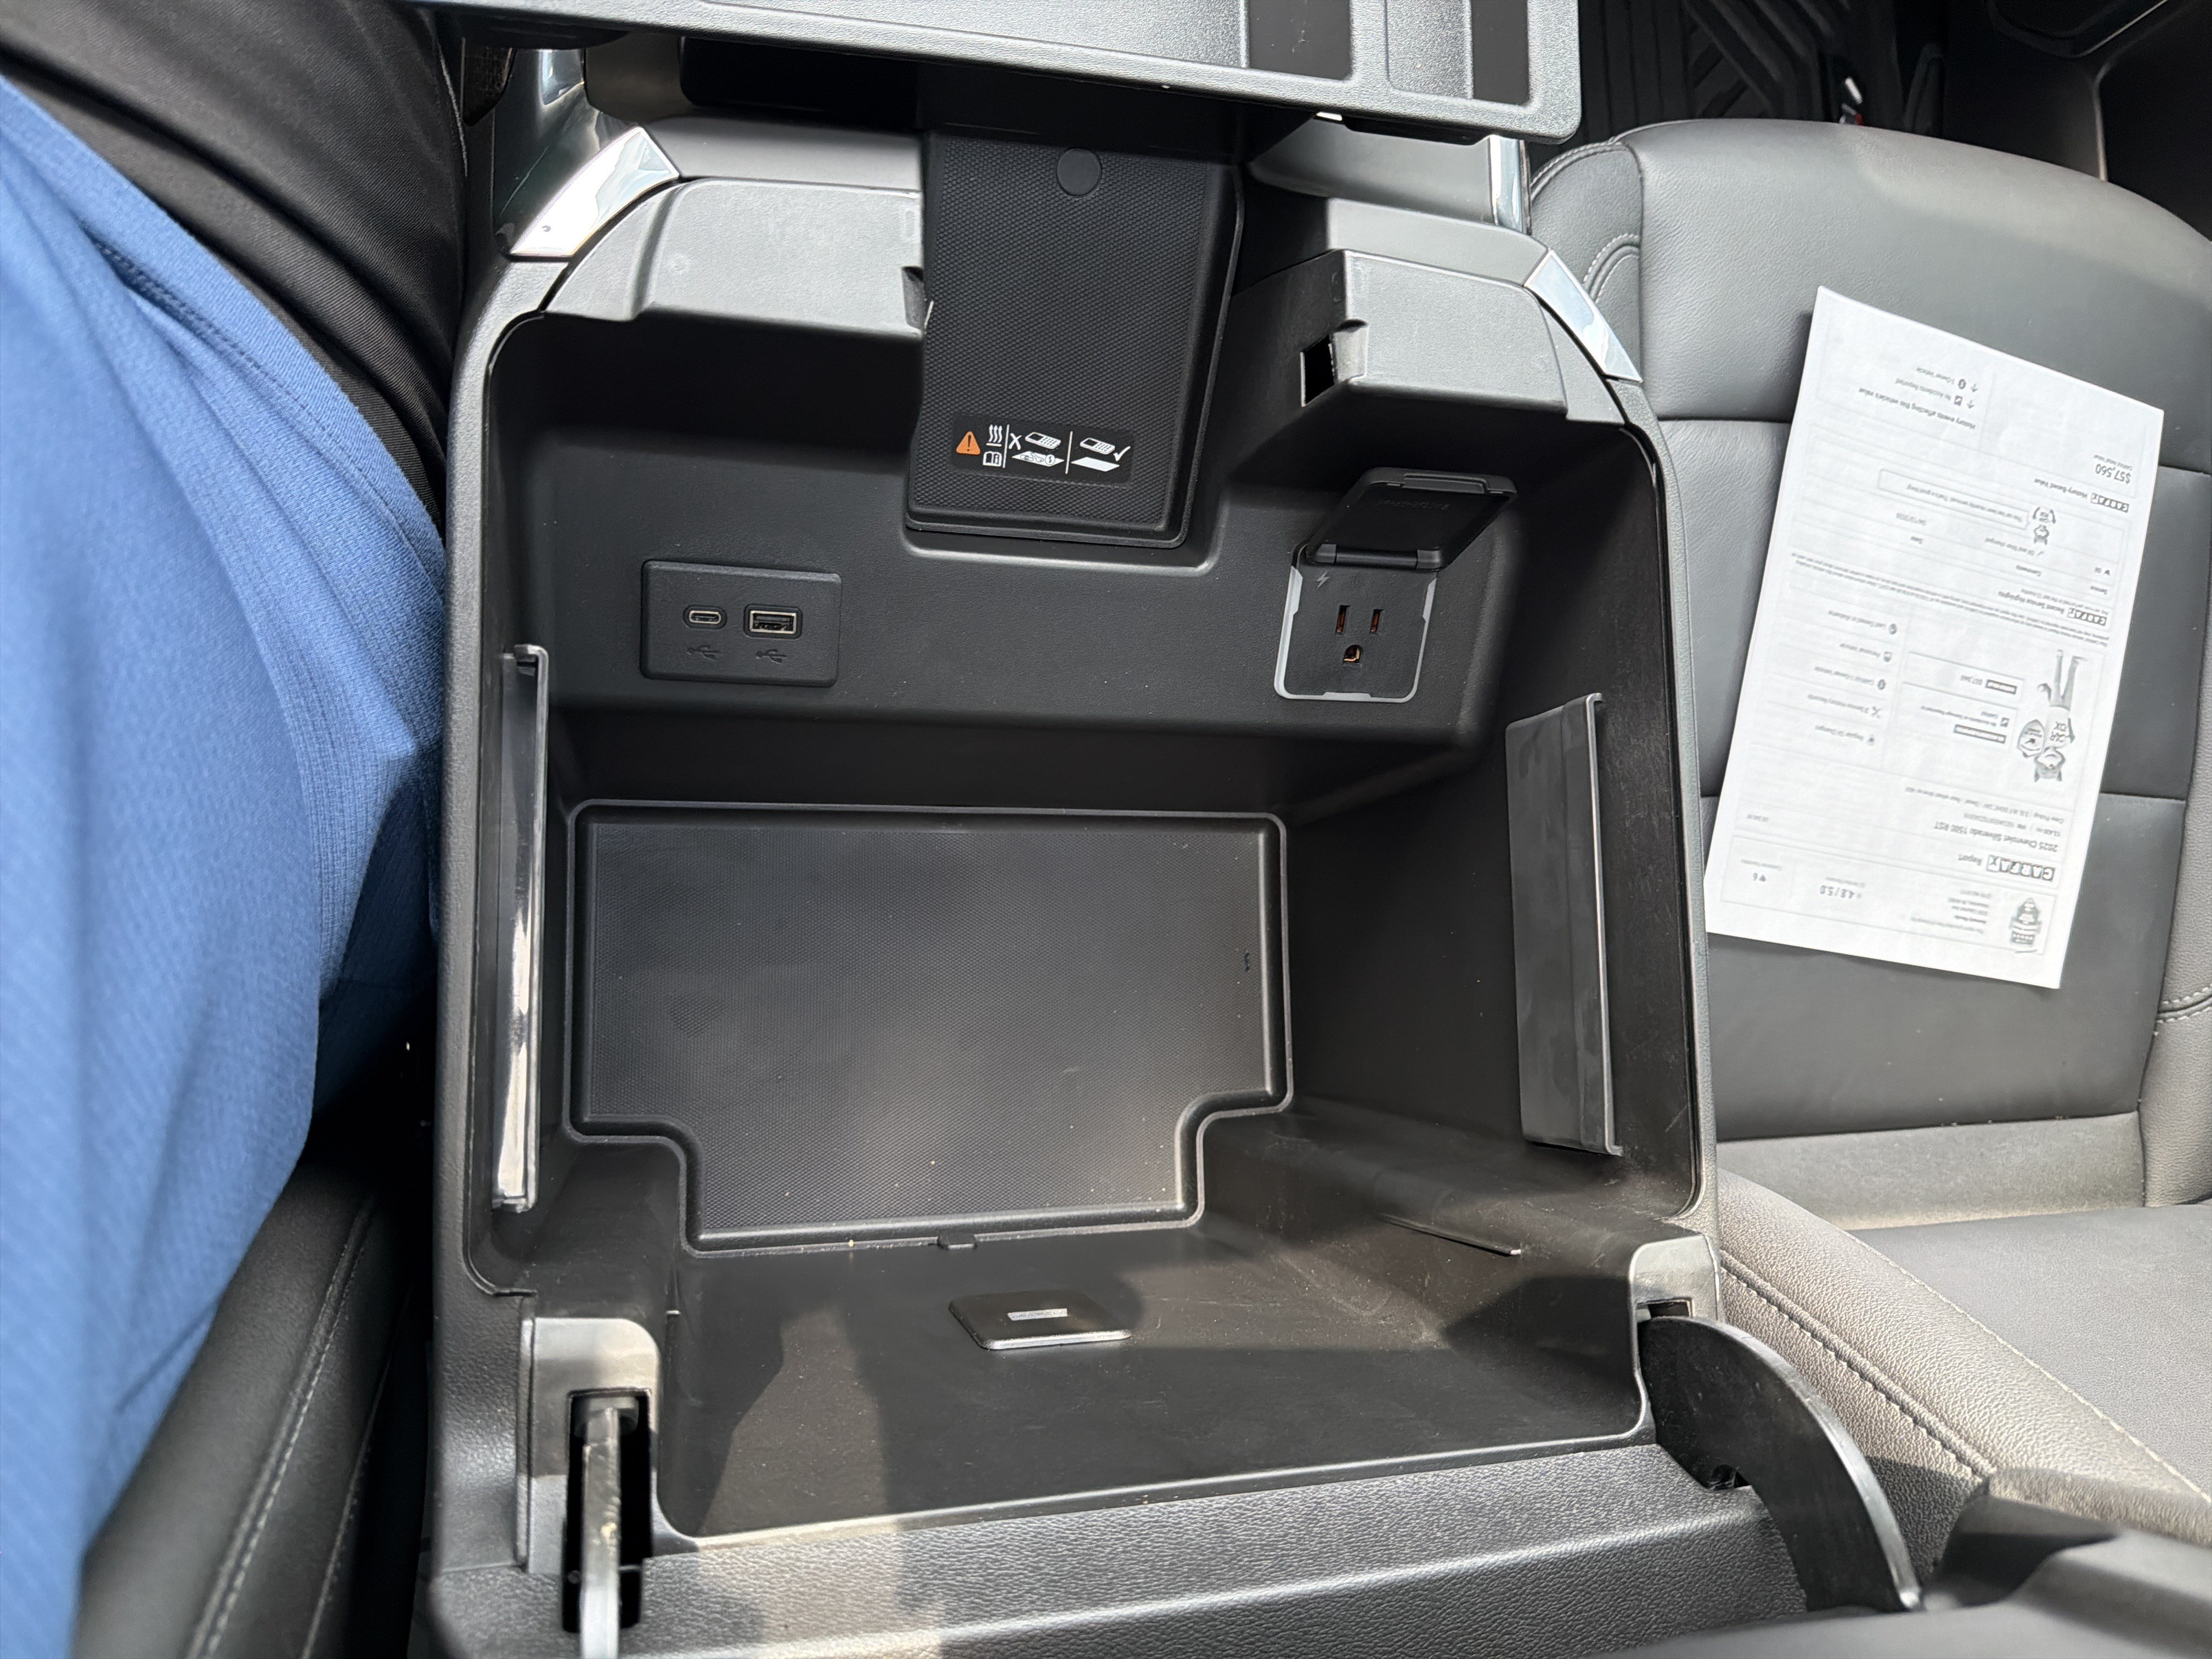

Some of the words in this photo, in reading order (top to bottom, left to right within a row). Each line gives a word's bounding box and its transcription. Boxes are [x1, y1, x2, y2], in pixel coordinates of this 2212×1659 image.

[1916, 366, 1934, 377] Vehicle
[1895, 378, 1919, 391] Reported
[1859, 388, 1874, 396] value
[1919, 386, 1944, 398] Accidents
[1875, 393, 1898, 404] vehicle's
[1900, 400, 1910, 409] this
[1911, 403, 1936, 417] affecting
[1937, 413, 1955, 422] events
[1955, 417, 1976, 430] History
[2095, 464, 2131, 484] $57,560
[2034, 478, 2049, 488] Value
[2049, 483, 2087, 499] History-Based
[1910, 536, 1923, 544] Date
[1984, 537, 2006, 547] changed
[2016, 565, 2041, 577] Comments
[2090, 586, 2108, 595] Service
[1998, 591, 2025, 603] Highlights
[2026, 599, 2045, 609] Service
[2046, 605, 2065, 614] Recent
[2067, 607, 2107, 626] CARFAX
[1933, 821, 1949, 831] RST
[1950, 825, 1967, 834] 1500
[1969, 828, 2002, 842] Silverado
[2004, 835, 2038, 849] Chevrolet
[2038, 842, 2058, 852] 2025
[1958, 854, 1982, 866] Report
[1986, 855, 2055, 882] CARFAX
[1753, 873, 1758, 881] 6
